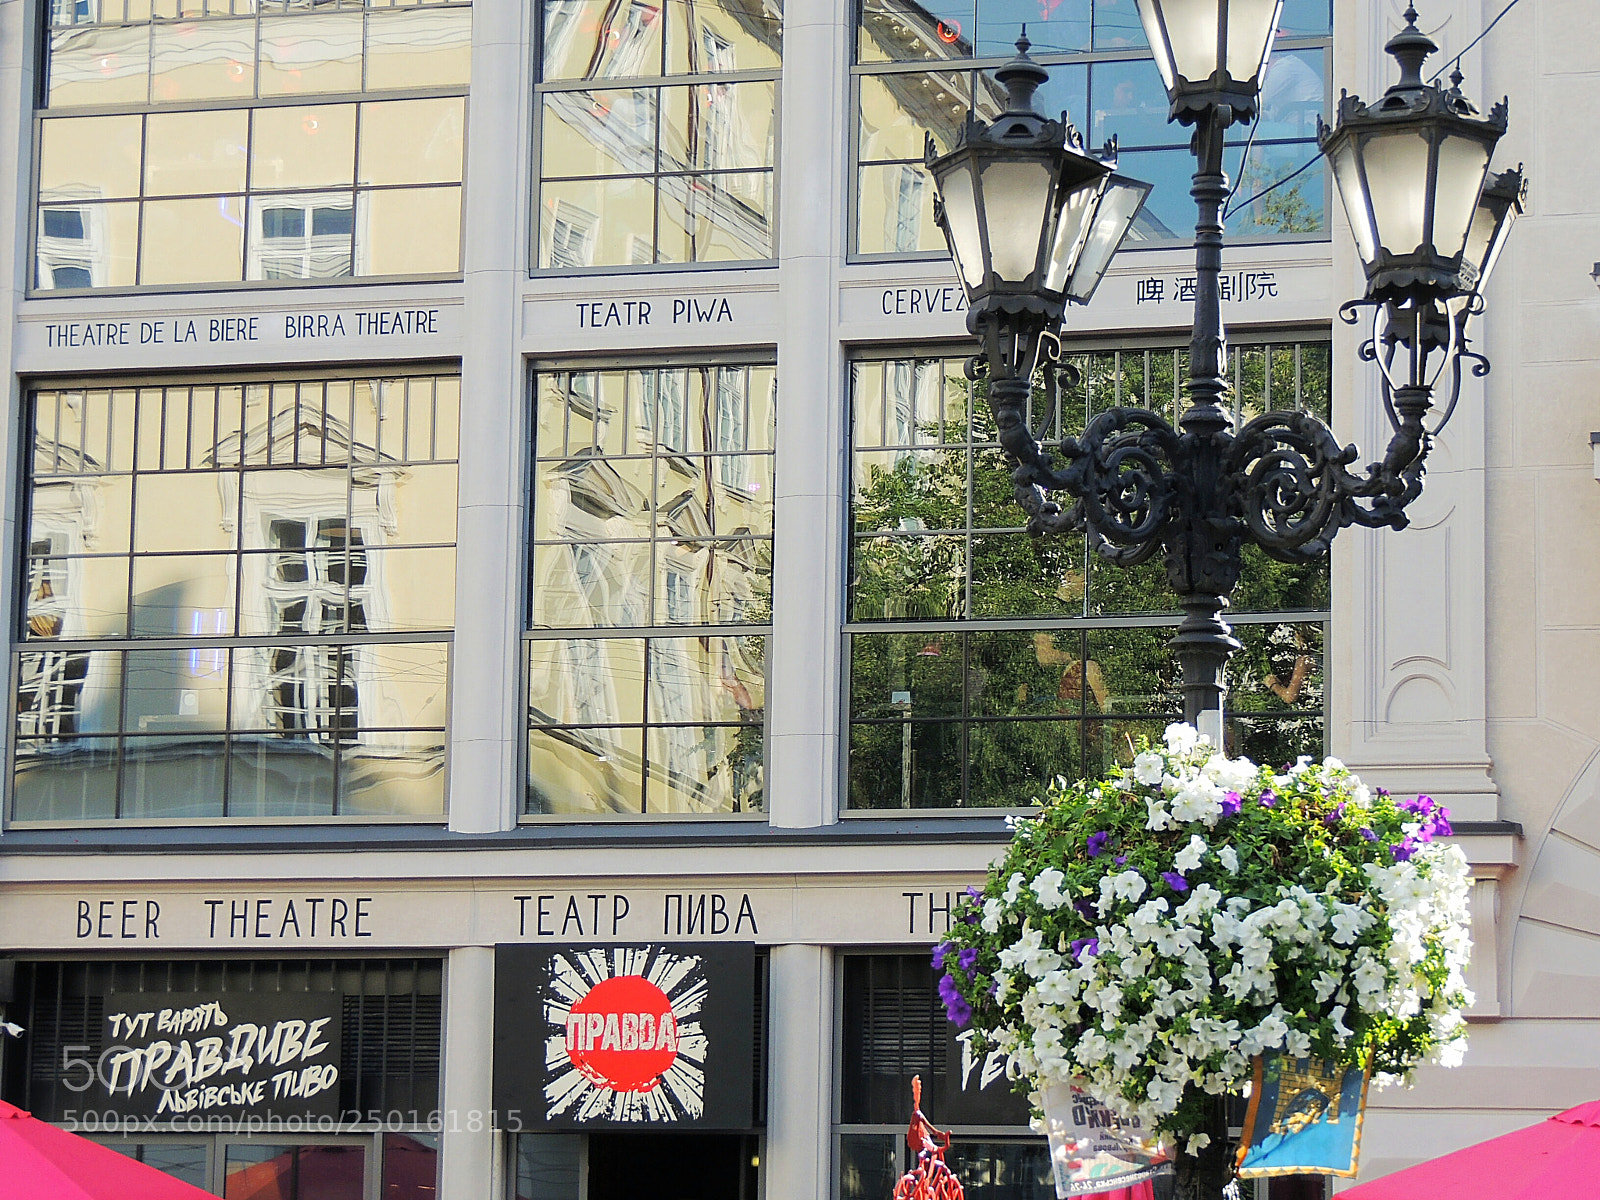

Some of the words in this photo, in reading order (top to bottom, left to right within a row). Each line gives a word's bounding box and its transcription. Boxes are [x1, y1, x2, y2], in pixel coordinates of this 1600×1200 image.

[285, 313, 346, 339] BIRRA
[355, 310, 439, 336] THEATRE
[575, 302, 651, 328] TEATR
[672, 298, 733, 324] PIWA
[46, 323, 130, 348] THEATRE
[140, 321, 164, 344] DE
[174, 319, 197, 343] LA
[209, 317, 259, 342] BIERE
[76, 900, 161, 939] BEER
[205, 897, 373, 938] THEATRE
[514, 895, 630, 936] ТЕАТР
[663, 894, 759, 935] ПИВА
[108, 1012, 155, 1040] ТУТ
[157, 1001, 229, 1035] ВАРЯТЬ
[108, 1017, 332, 1098] ПРАВДИВЕ
[271, 1064, 338, 1100] ПИВО
